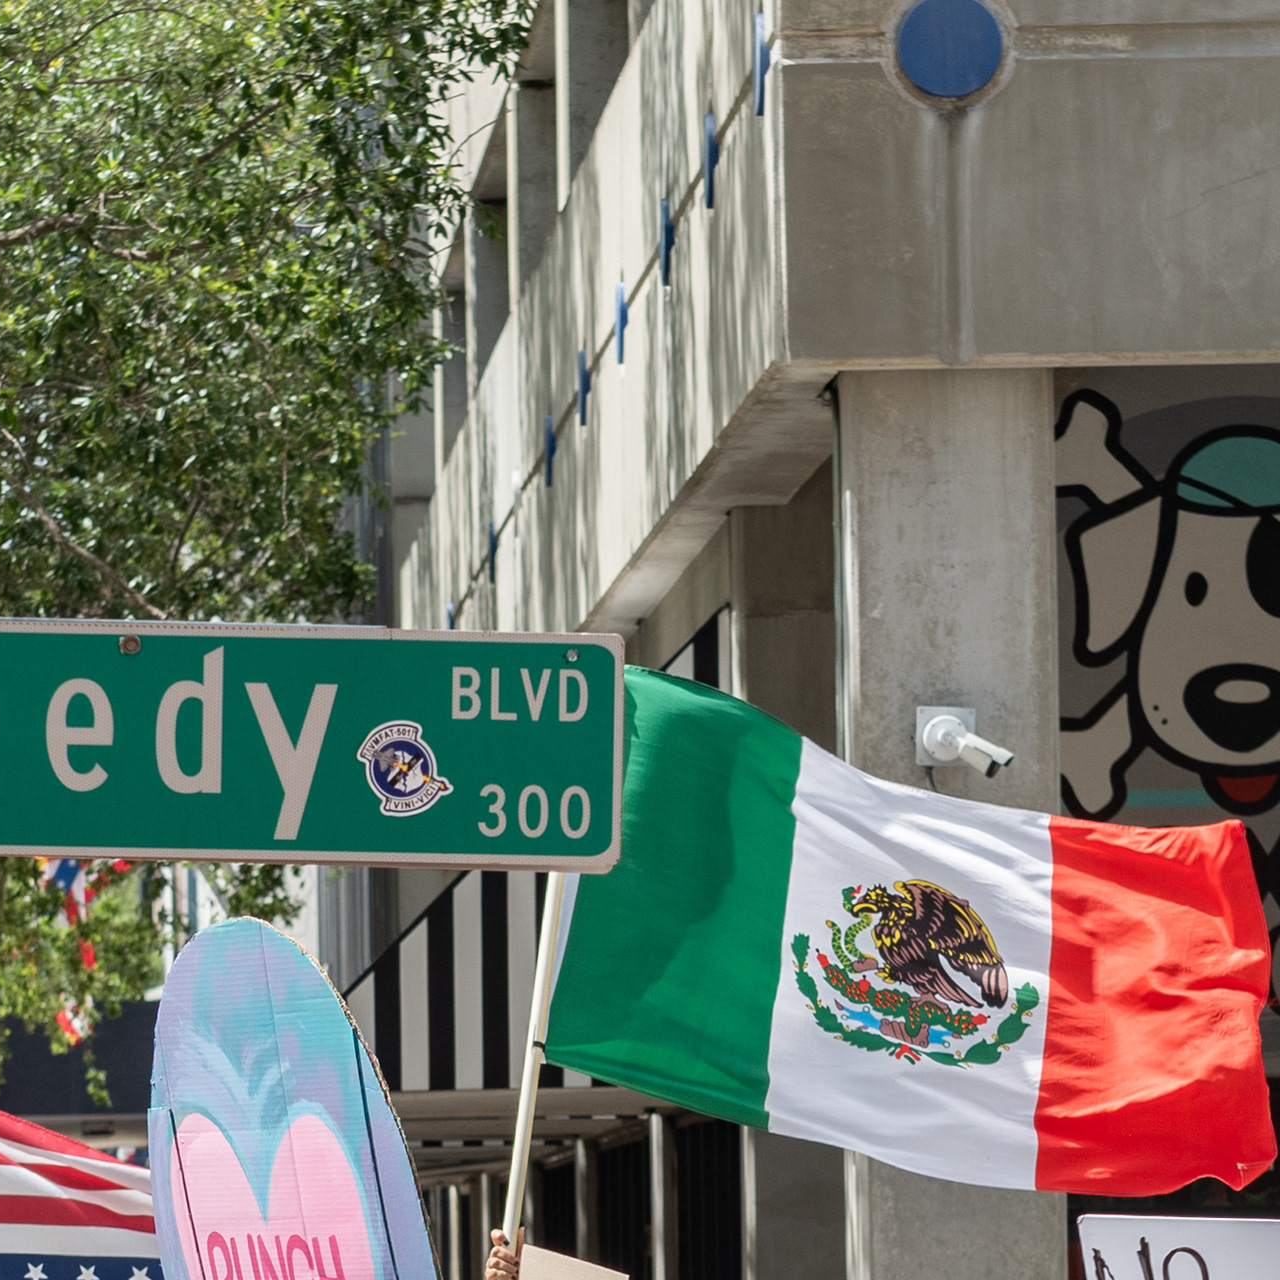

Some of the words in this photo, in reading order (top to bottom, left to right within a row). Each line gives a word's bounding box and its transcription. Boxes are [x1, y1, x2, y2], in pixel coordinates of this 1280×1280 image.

[451, 666, 589, 722] BLVD
[368, 728, 411, 751] VMFAT-501
[393, 785, 436, 810] VINI-VICI
[477, 784, 591, 839] 300
